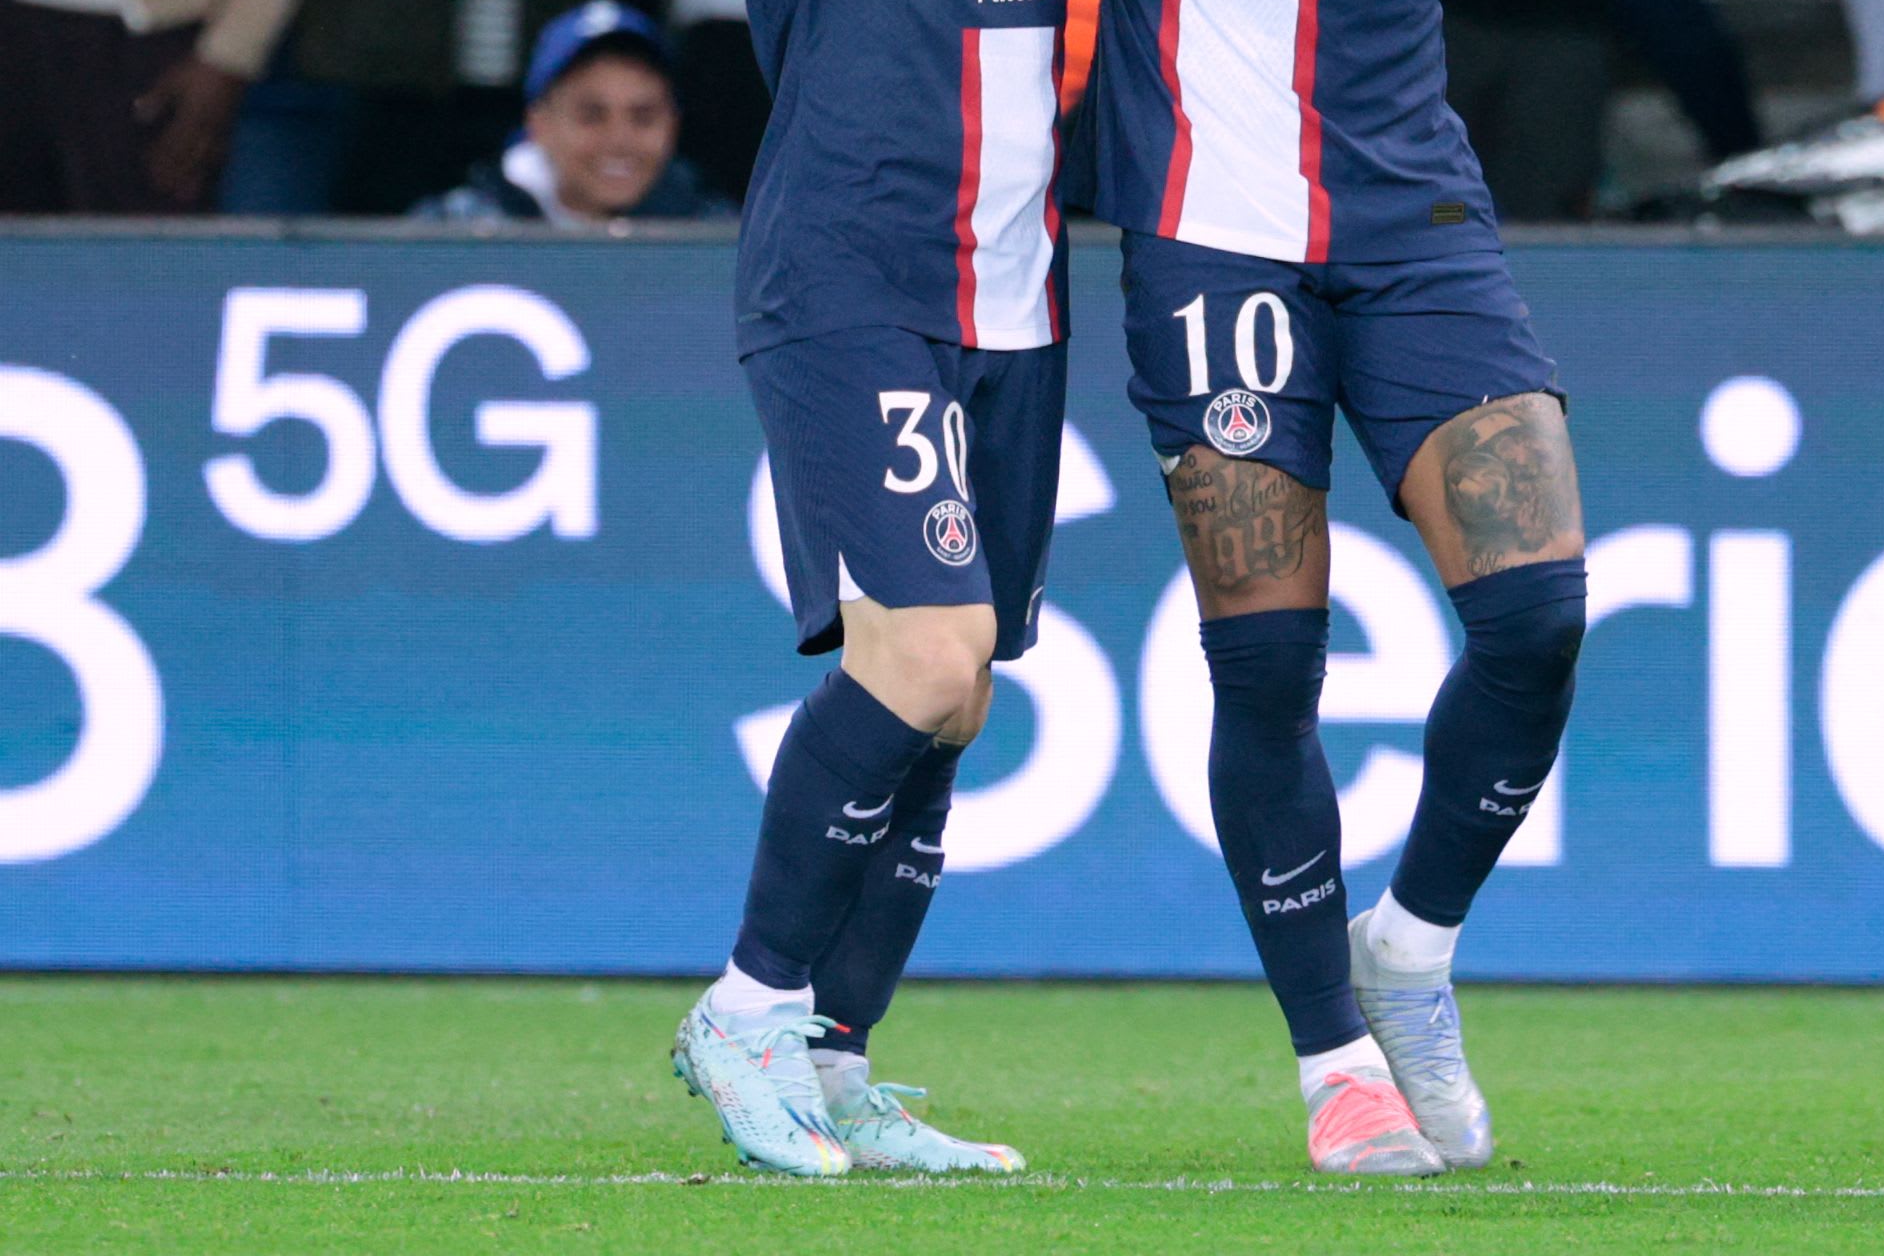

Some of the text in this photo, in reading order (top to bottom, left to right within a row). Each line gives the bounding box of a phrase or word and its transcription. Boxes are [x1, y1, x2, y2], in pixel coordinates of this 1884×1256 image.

[1172, 291, 1294, 397] 10
[204, 285, 598, 542] 5G
[1213, 393, 1257, 412] PARIS
[877, 390, 969, 502] 30
[931, 503, 967, 521] PARIS
[1479, 797, 1534, 816] PAR
[1262, 878, 1336, 915] PARIS
